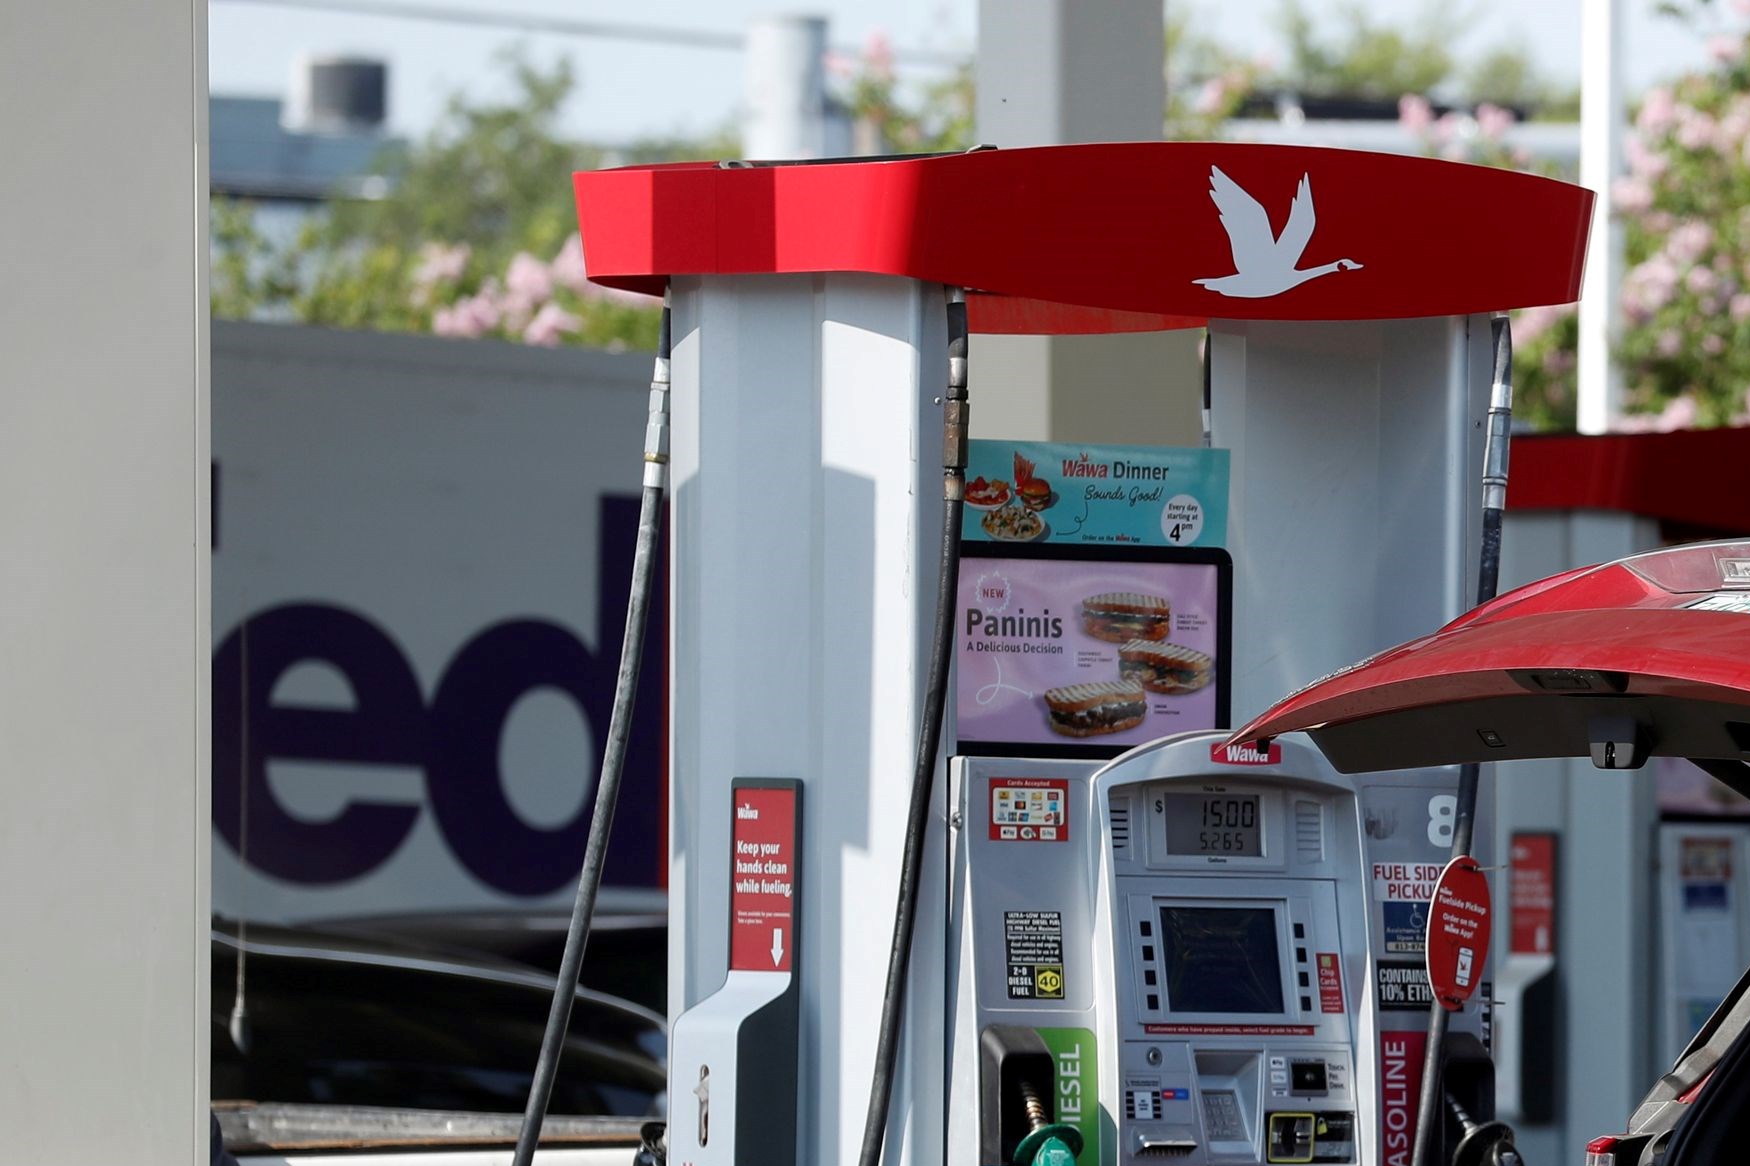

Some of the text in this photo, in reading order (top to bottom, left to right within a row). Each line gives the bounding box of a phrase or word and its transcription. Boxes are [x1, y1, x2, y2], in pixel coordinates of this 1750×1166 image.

[1062, 459, 1169, 481] Wawa Dinner
[1084, 484, 1165, 507] Sounds Good!
[1168, 503, 1198, 513] Every day
[1167, 513, 1191, 522] starting
[1169, 523, 1181, 542] 4
[982, 588, 1004, 599] NEW
[966, 608, 1063, 638] Paninis
[967, 641, 1063, 655] A Delicious Decision
[211, 458, 668, 902] ed
[737, 808, 758, 819] Wawa
[1155, 800, 1163, 814] $
[1427, 795, 1457, 848] 8
[737, 840, 780, 857] Keep your
[736, 859, 787, 874] hands clean
[1373, 865, 1411, 880] FUEL
[736, 879, 760, 893] while
[1388, 883, 1435, 899] PICKU
[1465, 902, 1487, 916] Pickup
[1443, 912, 1460, 924] Order
[1008, 976, 1059, 988] DIESEL 40
[1379, 969, 1429, 984] CONTAINS
[1012, 986, 1030, 996] FUEL
[1381, 984, 1433, 1001] 10% ETH
[1059, 1043, 1082, 1122] IESEL
